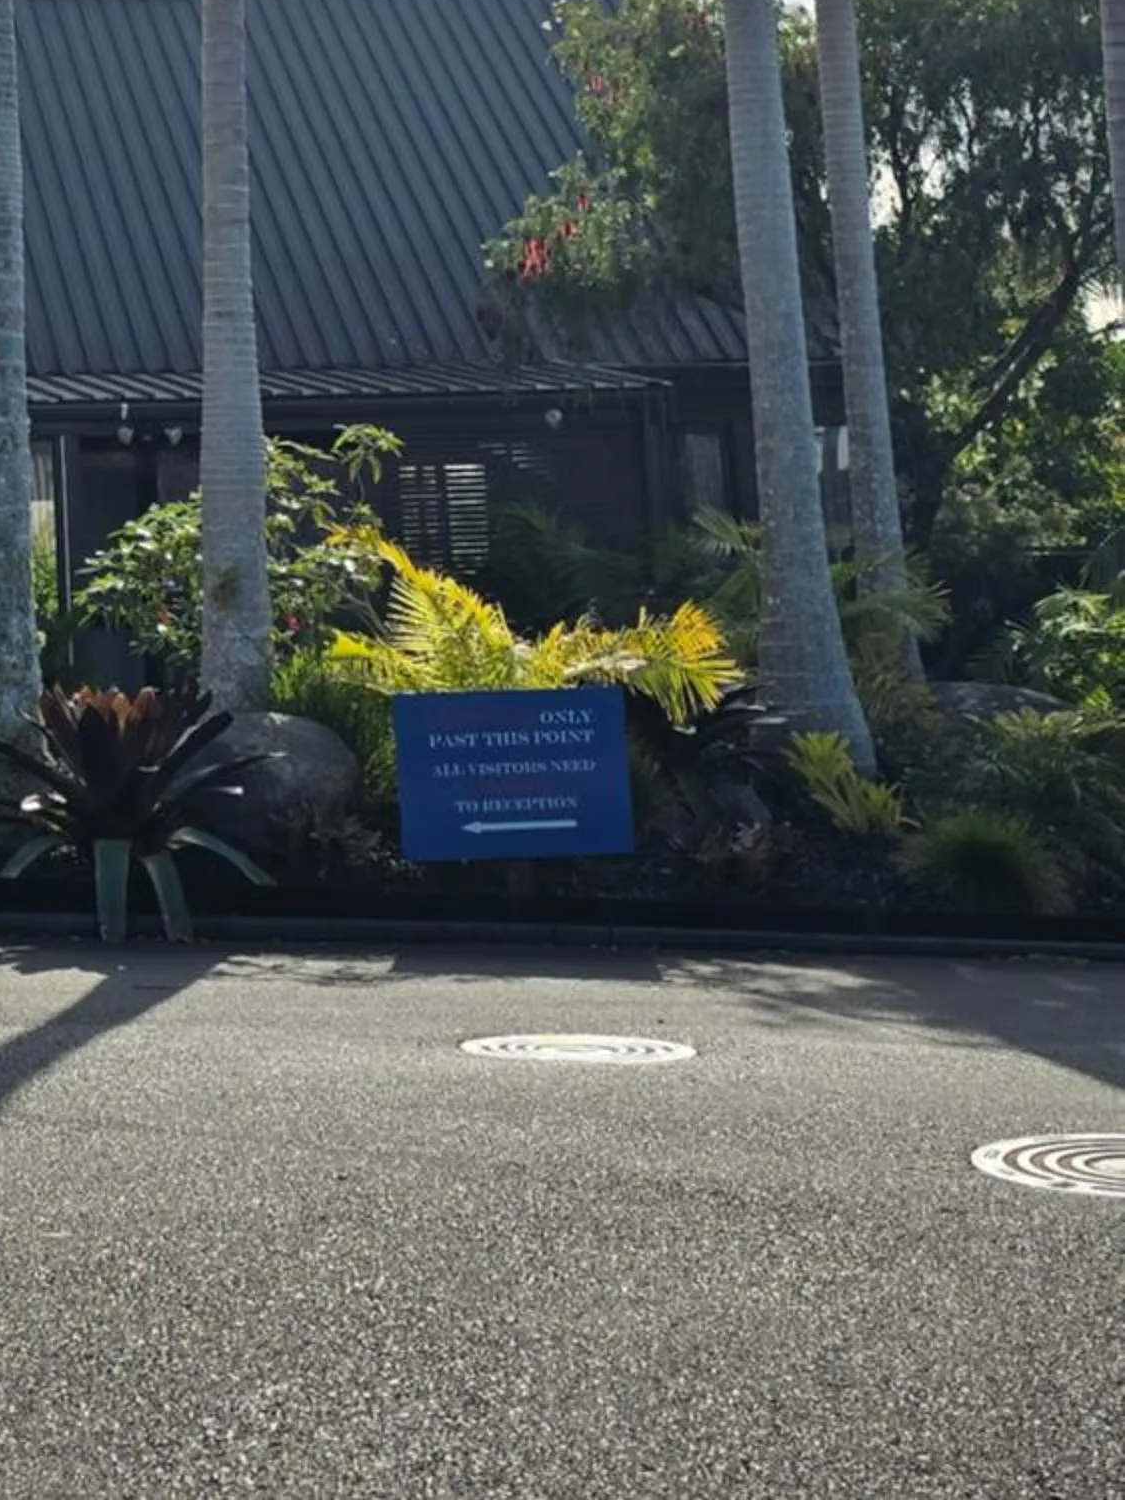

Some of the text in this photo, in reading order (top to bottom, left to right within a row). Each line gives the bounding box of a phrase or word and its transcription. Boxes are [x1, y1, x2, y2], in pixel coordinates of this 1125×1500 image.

[539, 708, 594, 725] ONLY
[429, 729, 595, 749] PAST THIS POINT
[432, 758, 596, 778] ALL VISITORS NEED
[453, 796, 578, 814] TO RECEPTION
